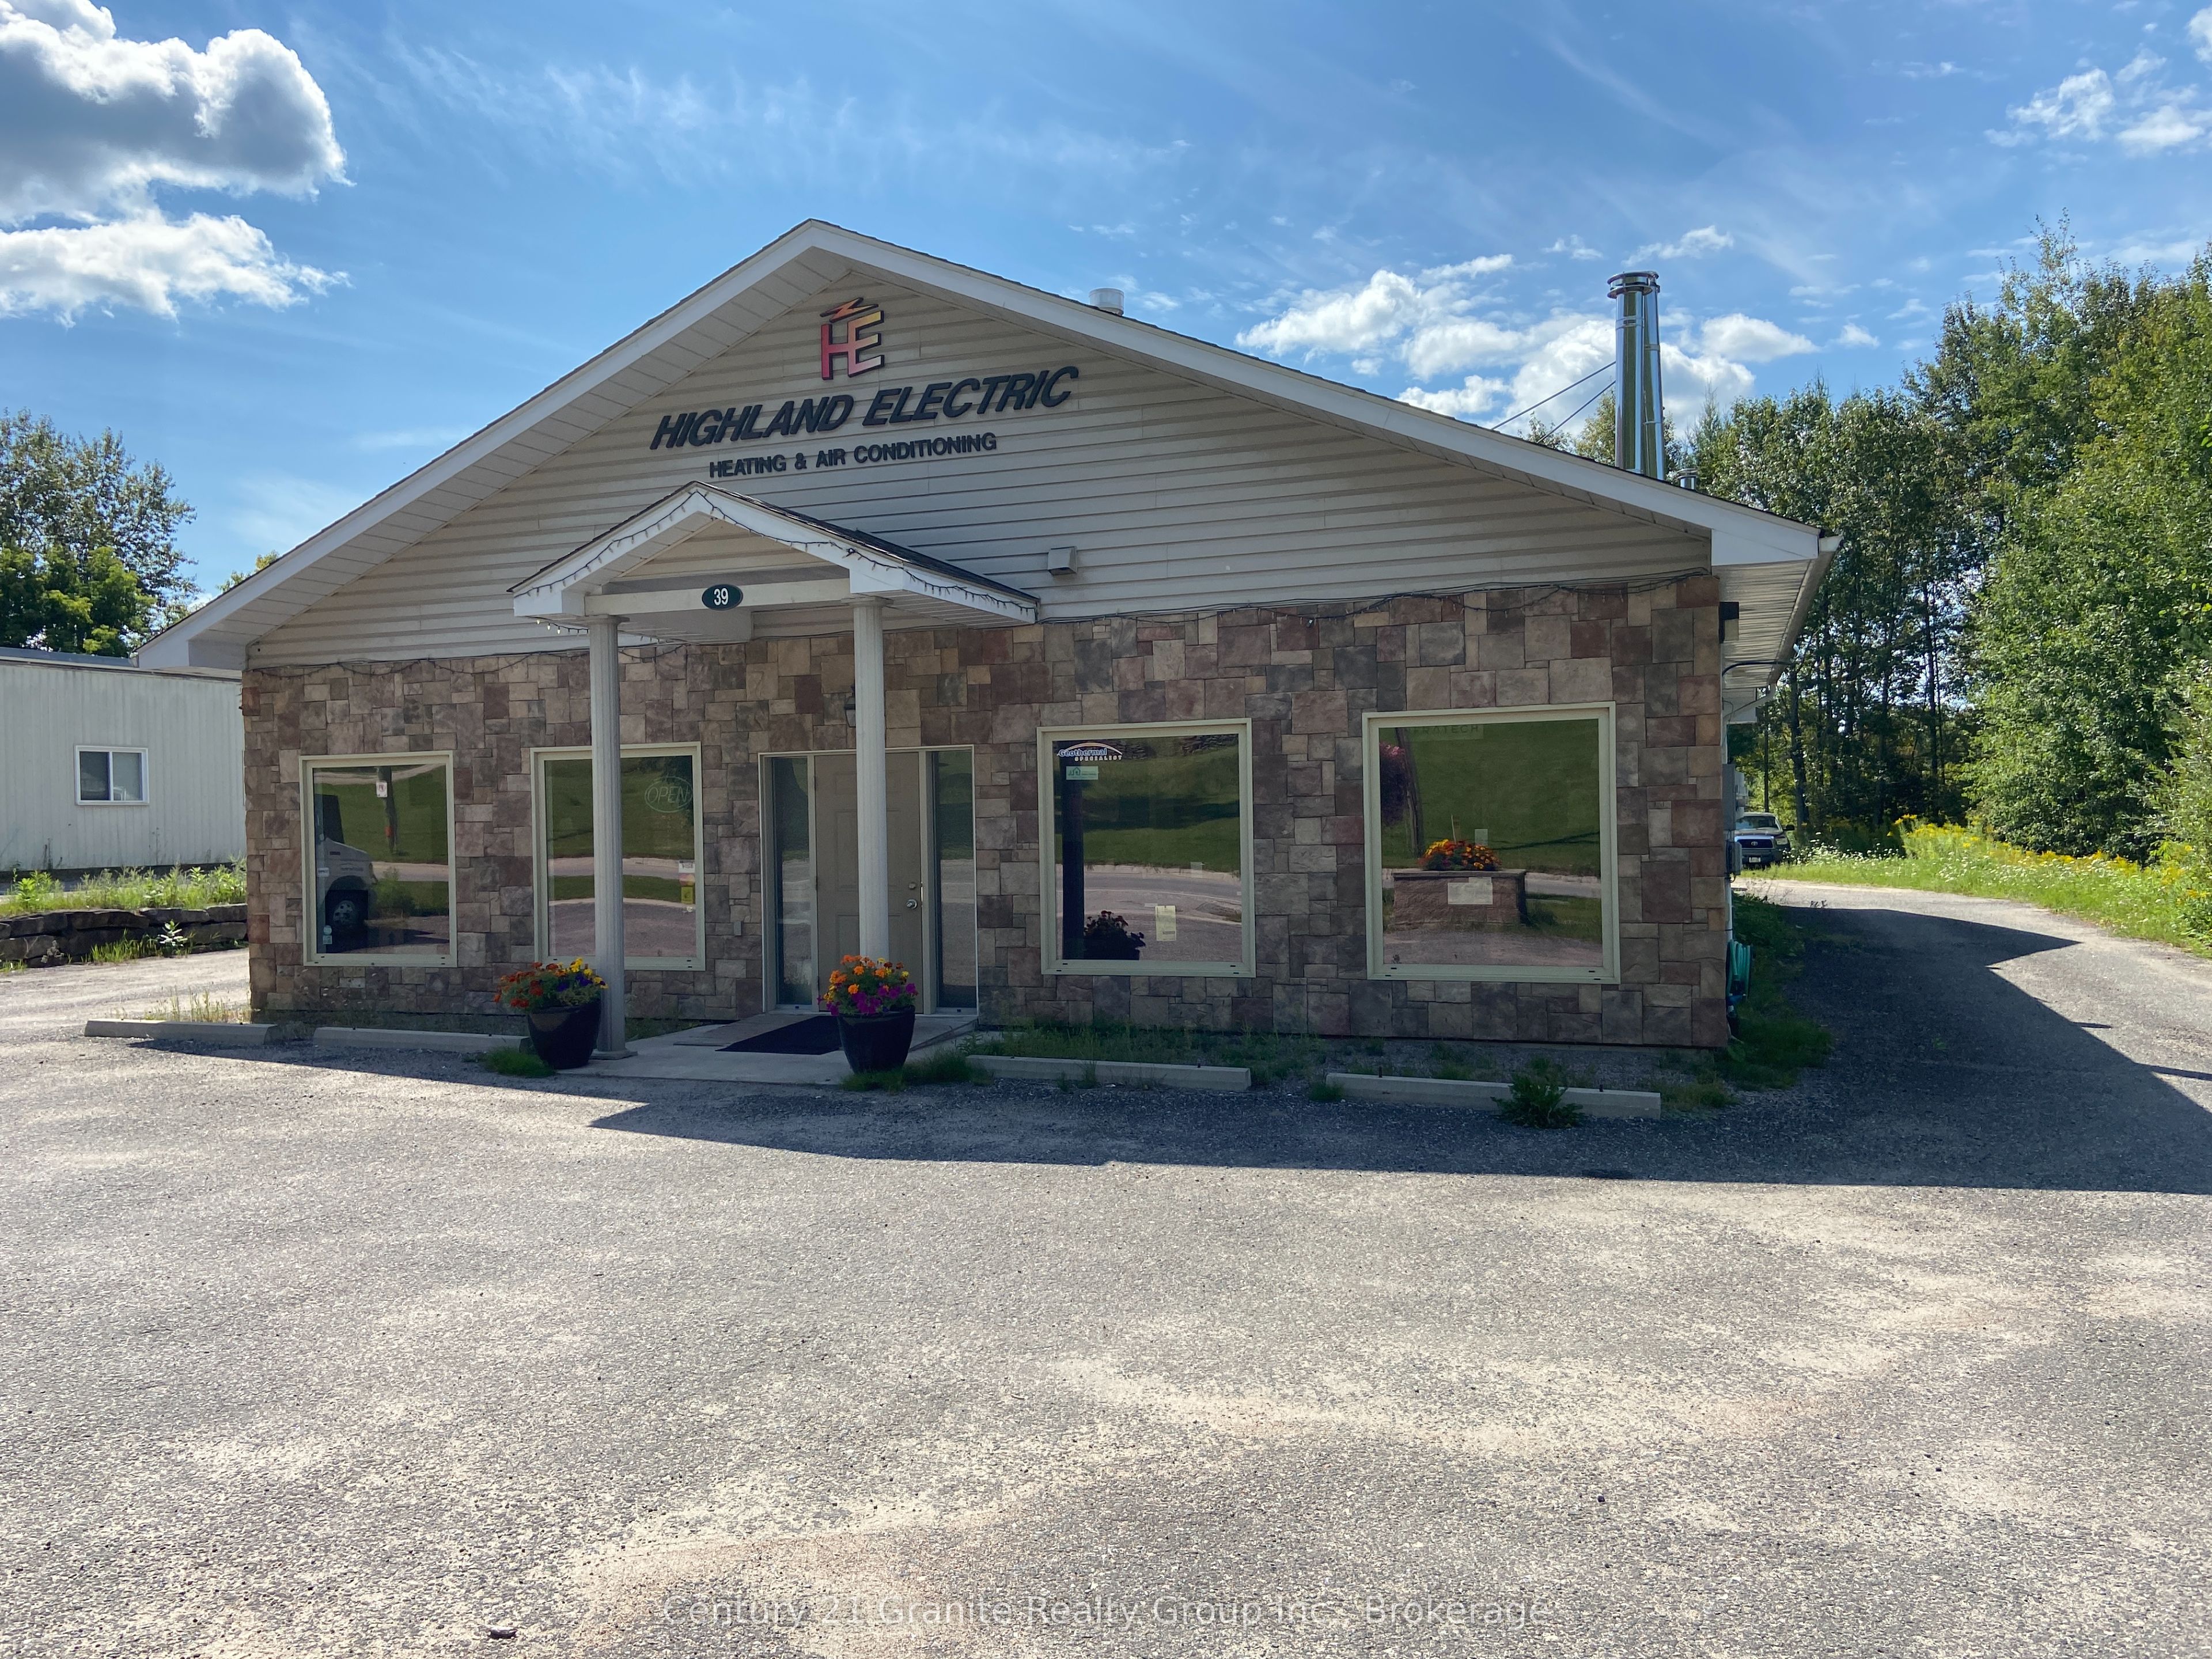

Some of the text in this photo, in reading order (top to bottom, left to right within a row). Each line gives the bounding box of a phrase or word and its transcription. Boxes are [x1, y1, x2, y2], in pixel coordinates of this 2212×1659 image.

[650, 366, 1079, 450] HIGHLAND ELECTRIC
[709, 432, 997, 478] HEATING & AIR CONDITIONING
[714, 588, 729, 605] 39
[1059, 748, 1107, 757] Geothermal
[647, 786, 688, 805] OPEN
